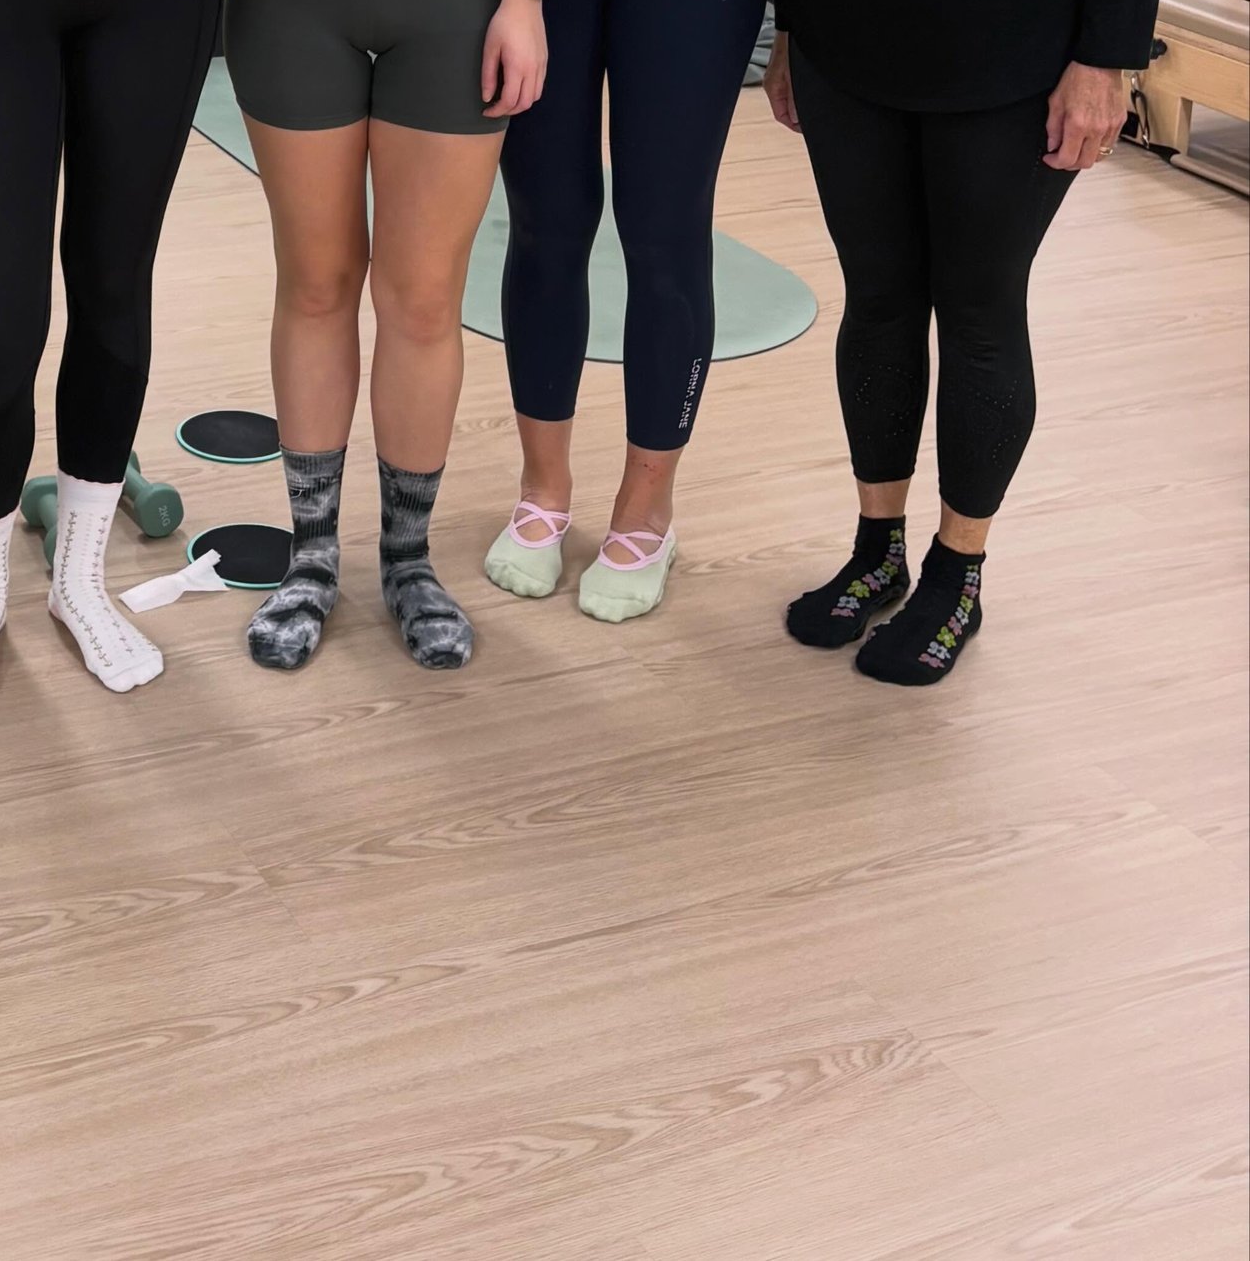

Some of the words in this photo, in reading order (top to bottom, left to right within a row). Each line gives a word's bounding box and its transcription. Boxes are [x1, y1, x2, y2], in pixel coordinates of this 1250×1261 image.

[685, 357, 703, 399] LORNA
[678, 400, 693, 429] JANE
[158, 504, 171, 527] 2KG
